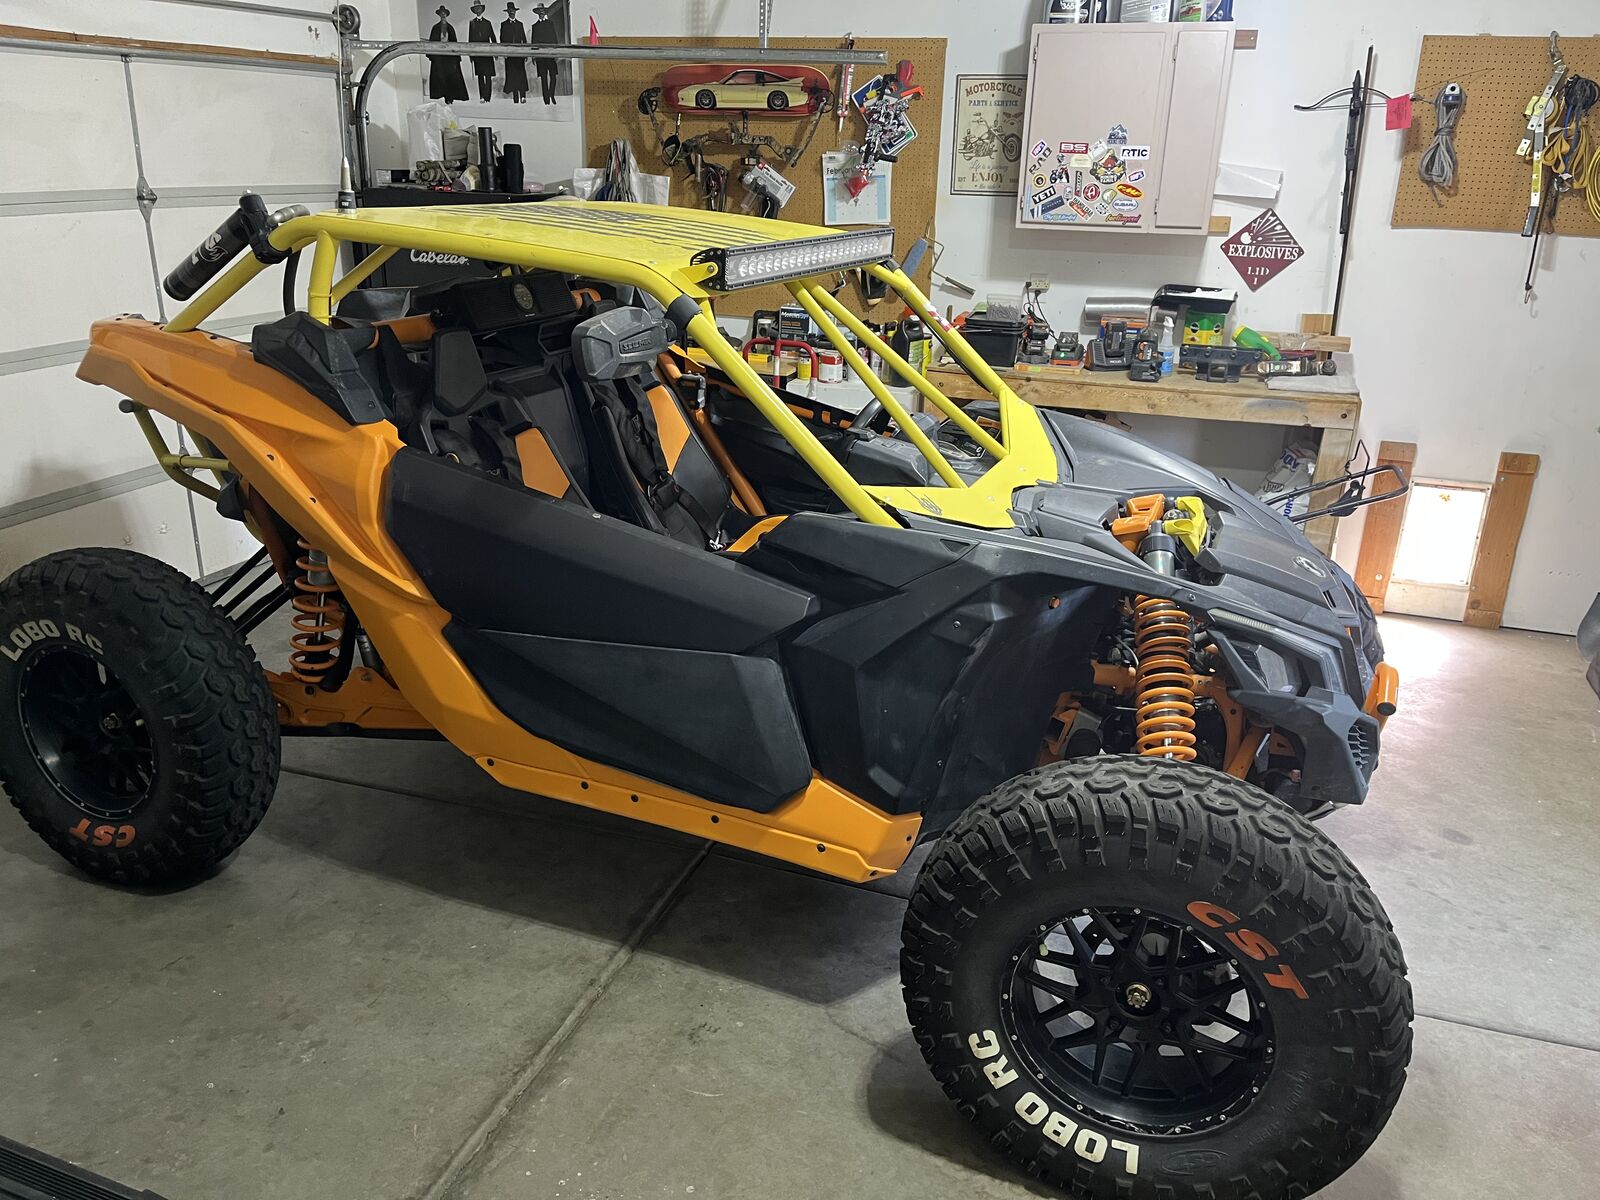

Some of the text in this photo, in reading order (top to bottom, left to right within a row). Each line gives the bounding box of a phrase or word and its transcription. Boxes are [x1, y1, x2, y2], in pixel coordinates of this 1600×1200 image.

[965, 82, 1022, 97] MOTORCYCLE
[1061, 143, 1087, 151] BS
[1122, 148, 1148, 157] RTIC
[971, 172, 1003, 183] ENJOY
[1033, 187, 1055, 203] YETI
[1228, 244, 1299, 260] EXPLOSIVES
[0, 619, 104, 661] LOBO RC
[69, 818, 137, 848] CST
[1186, 900, 1310, 1000] CST
[967, 1028, 1141, 1175] LOBO RC
